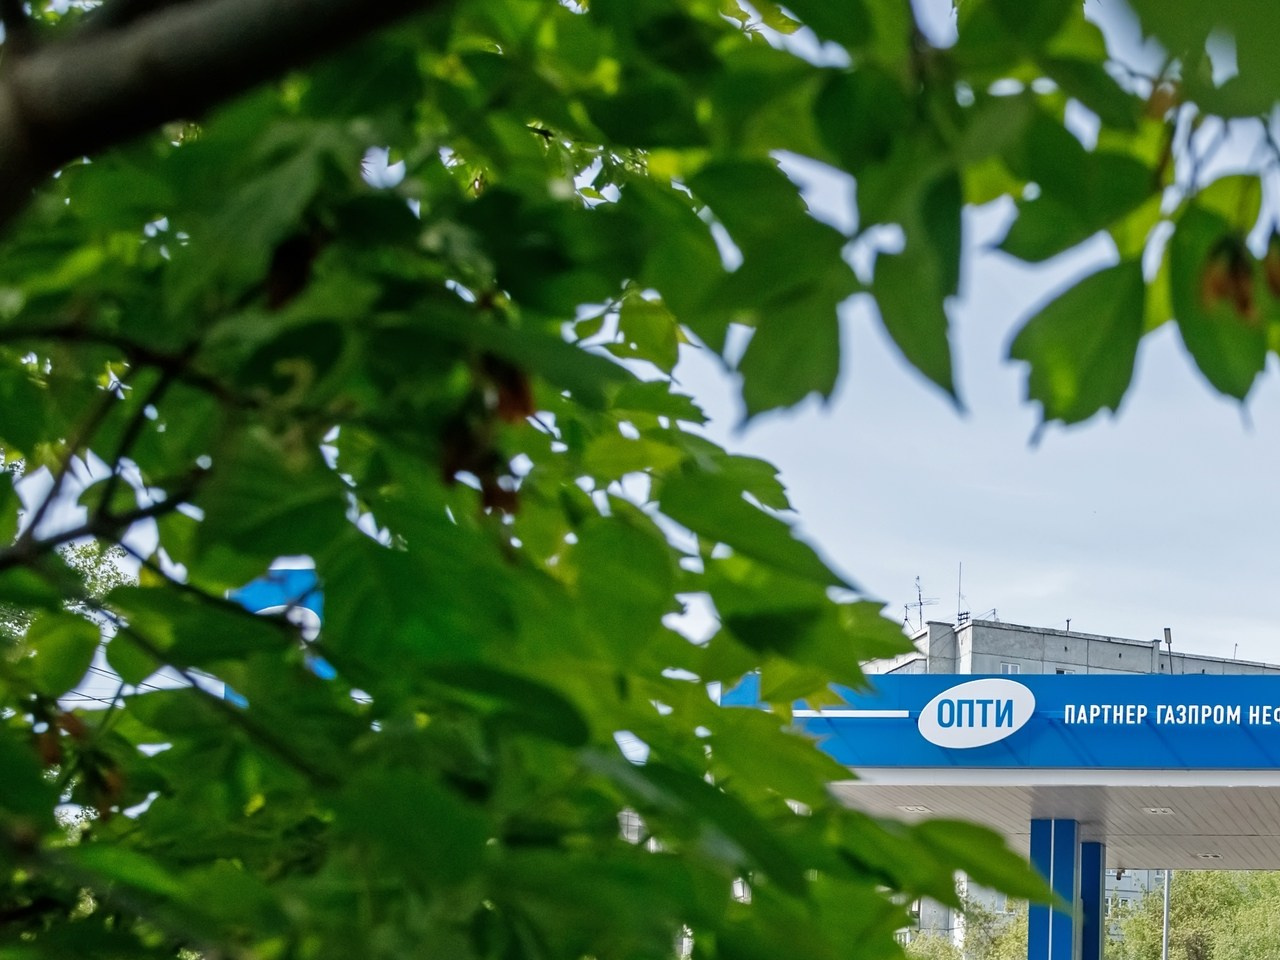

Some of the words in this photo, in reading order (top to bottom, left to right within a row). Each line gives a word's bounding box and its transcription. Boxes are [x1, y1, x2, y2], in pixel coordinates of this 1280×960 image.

[937, 698, 1014, 728] ОПТИ
[1064, 704, 1148, 725] ПАРТНЕР
[1156, 704, 1241, 725] ГАЗПРОМ
